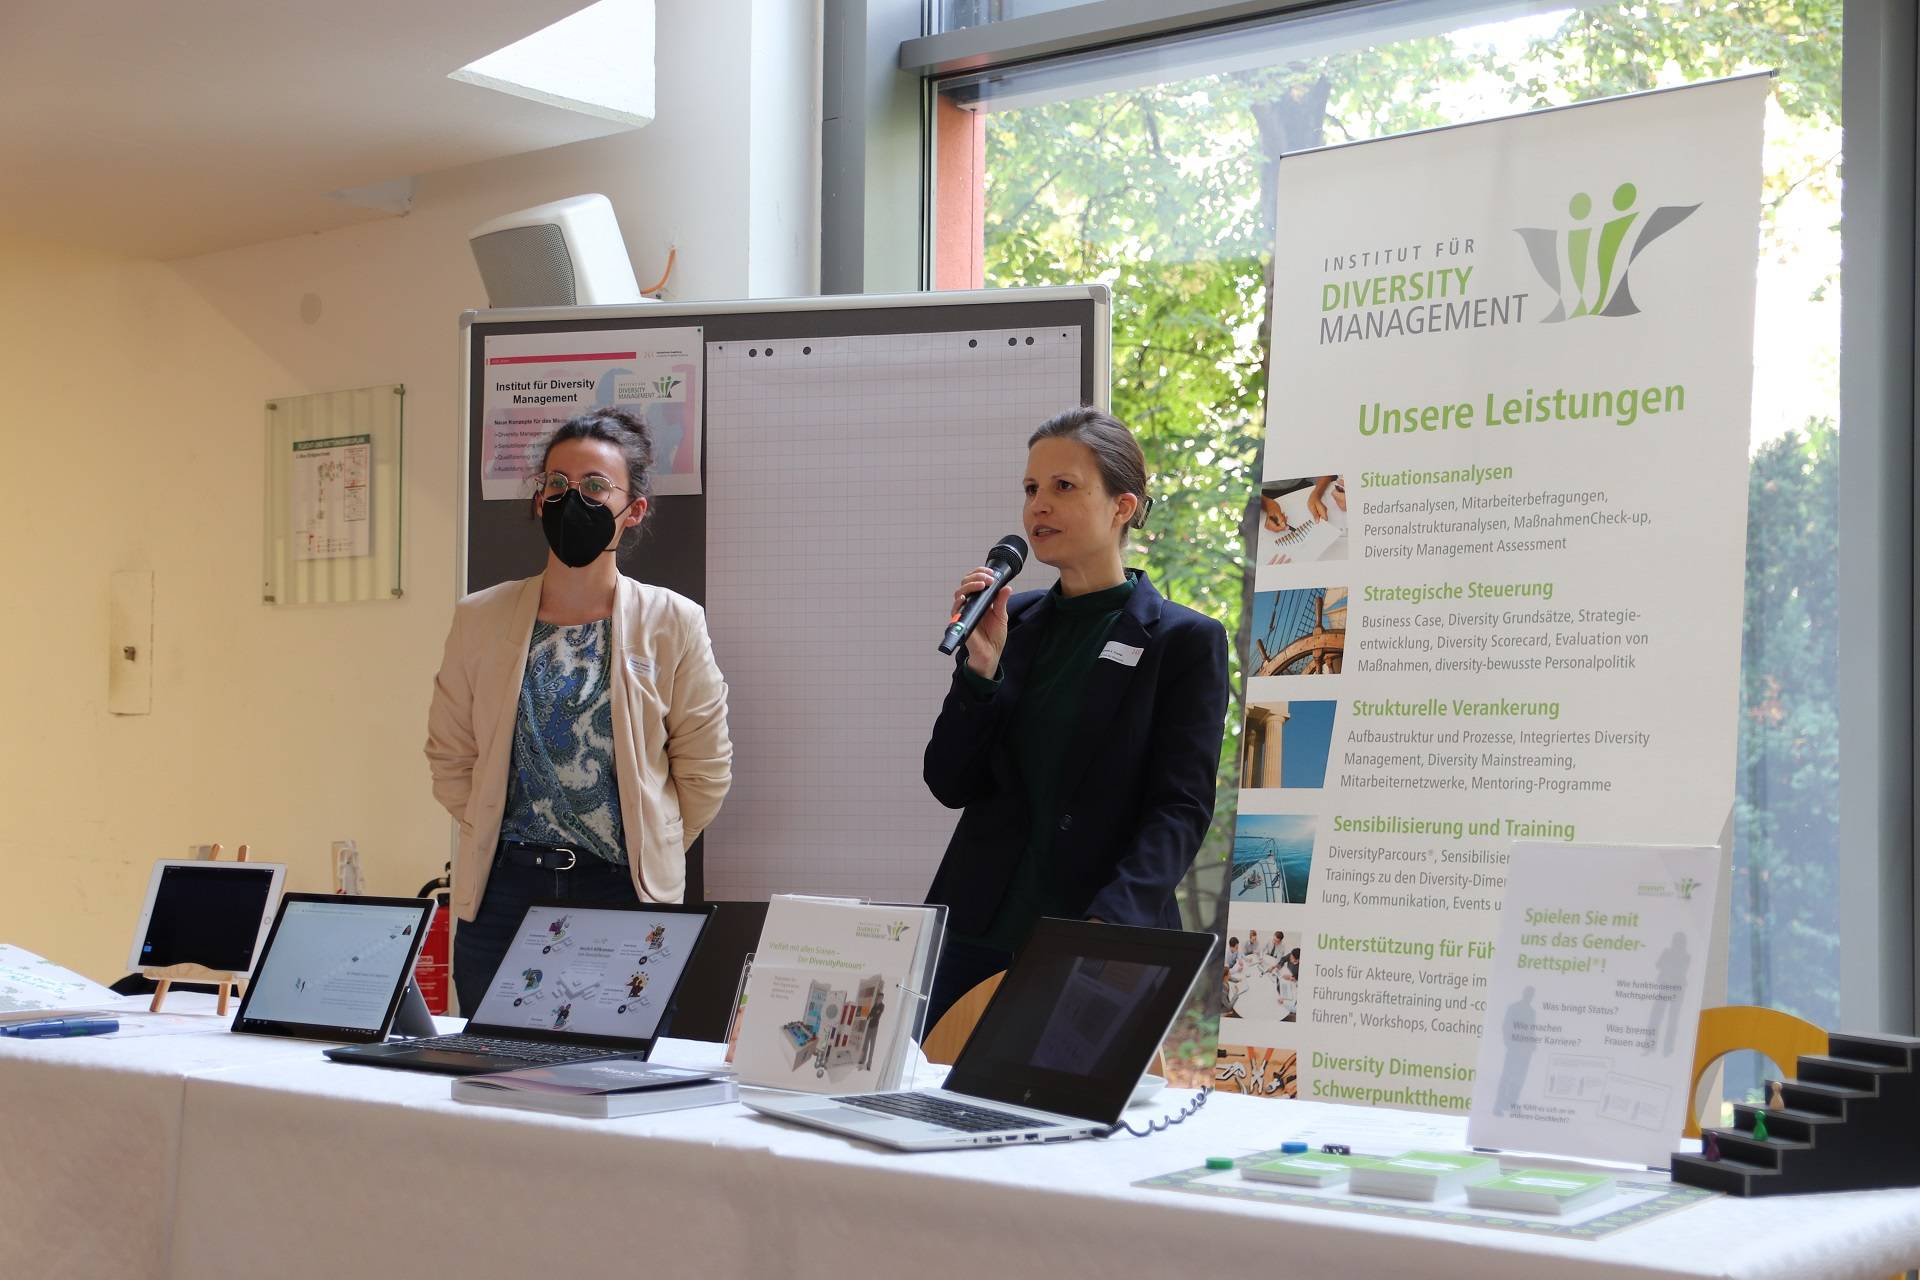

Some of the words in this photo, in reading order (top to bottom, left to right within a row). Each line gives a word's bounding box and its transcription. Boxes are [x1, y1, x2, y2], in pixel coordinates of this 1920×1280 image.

[1324, 245, 1422, 272] INSTITUT
[1435, 237, 1475, 257] FÜR
[1321, 265, 1474, 311] DIVERSITY
[1320, 293, 1528, 344] MANAGEMENT
[496, 381, 531, 391] Institut
[533, 380, 548, 390] für
[550, 379, 595, 390] Diversity
[513, 393, 577, 405] Management
[1358, 402, 1473, 436] Unsere
[1485, 384, 1684, 426] Leistungen
[1360, 464, 1513, 488] Situationsanalysen
[1363, 499, 1458, 515] Bedarfsanalysen,
[1462, 490, 1608, 510] Mitarbeiterbefragungen,
[1364, 518, 1510, 537] Personalstrukturanalysen,
[1514, 510, 1651, 530] MaßnahmenCheck-up,
[1364, 544, 1413, 560] Diversity
[1416, 541, 1493, 557] Management
[1497, 537, 1567, 552] Assessment
[1363, 582, 1463, 604] Strategische
[1467, 581, 1553, 600] Steuerung
[1362, 615, 1411, 628] Business
[1414, 614, 1444, 628] Case,
[1448, 612, 1499, 628] Diversity
[1502, 610, 1574, 625] Grundsätze,
[1578, 608, 1641, 625] Strategie-
[1360, 635, 1433, 652] entwicklung,
[1437, 635, 1488, 651] Diversity
[1491, 633, 1551, 648] Scorecard,
[1555, 632, 1621, 646] Evaluation
[1625, 634, 1648, 645] von
[1358, 658, 1432, 673] Maßnahmen,
[1435, 656, 1541, 674] diversity-bewusste
[1545, 654, 1636, 672] Personalpolitik
[1352, 699, 1448, 716] Strukturelle
[1452, 698, 1560, 720] Verankerung
[1347, 729, 1434, 744] Aufbaustruktur
[1437, 730, 1459, 744] und
[1462, 730, 1516, 745] Prozesse,
[1520, 730, 1591, 747] Integriertes
[1594, 730, 1650, 748] Diversity
[1344, 753, 1424, 768] Management,
[1427, 753, 1478, 769] Diversity
[1481, 753, 1576, 771] Mainstreaming,
[1340, 774, 1467, 791] Mitarbeiternetzwerke,
[1471, 776, 1612, 793] Mentoring-Programme
[1333, 815, 1463, 839] Sensibilisierung
[1468, 818, 1500, 836] und
[1505, 819, 1575, 841] Training
[1441, 849, 1511, 865] Sensibilisier
[1325, 868, 1375, 885] Trainings
[1378, 873, 1391, 884] zu
[1394, 870, 1416, 884] den
[1321, 890, 1350, 906] lung,
[1353, 892, 1449, 911] Kommunikation,
[1453, 896, 1491, 911] Events
[1524, 907, 1581, 927] Spielen
[1585, 910, 1608, 926] Sie
[1612, 912, 1640, 928] mit
[1317, 933, 1434, 960] Unterstützung
[1440, 939, 1463, 957] für
[1468, 941, 1495, 959] Füh
[1520, 933, 1547, 947] uns
[1552, 932, 1578, 948] das
[1582, 933, 1647, 952] Gender-
[1314, 964, 1344, 978] Tools
[1347, 965, 1363, 979] für
[1365, 967, 1415, 985] Akteure,
[1419, 970, 1469, 989] Vorträge
[1312, 987, 1442, 1012] Führungskräftetraining
[1445, 996, 1467, 1010] und
[1542, 1002, 1560, 1012] Was
[1561, 1003, 1586, 1014] bringt
[1588, 1005, 1619, 1015] Status?
[1360, 1013, 1428, 1032] Workshops,
[1606, 1024, 1624, 1033] Was
[1604, 1036, 1633, 1047] Frauen
[1312, 1051, 1384, 1078] Diversity
[1389, 1058, 1477, 1082] Dimension
[1312, 1079, 1472, 1110] Schwerpunkttheme
